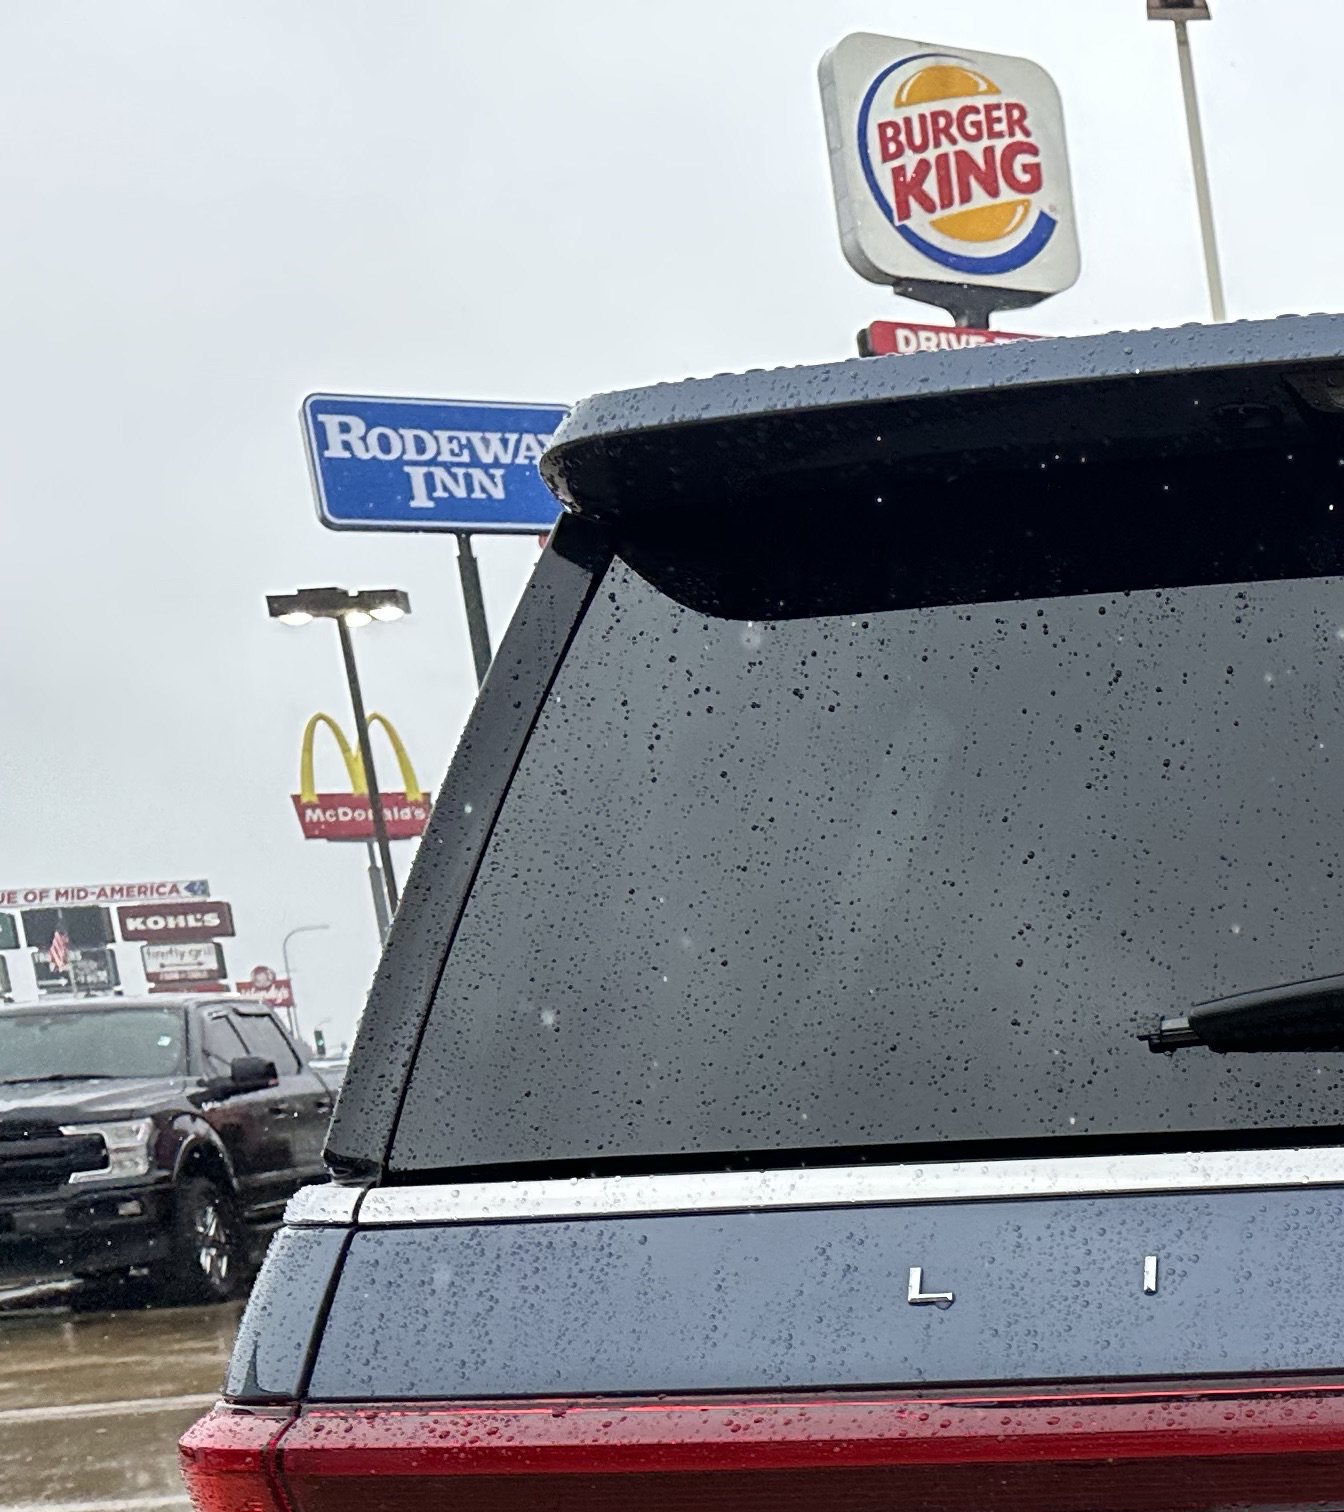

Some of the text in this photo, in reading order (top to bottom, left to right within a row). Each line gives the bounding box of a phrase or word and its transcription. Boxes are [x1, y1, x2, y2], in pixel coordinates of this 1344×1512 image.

[877, 102, 1033, 164] BURGER
[890, 140, 1044, 223] KING
[403, 466, 505, 508] INN
[24, 889, 48, 903] OF
[55, 883, 181, 901] MID-AMERICA
[125, 912, 221, 931] KOHL'S
